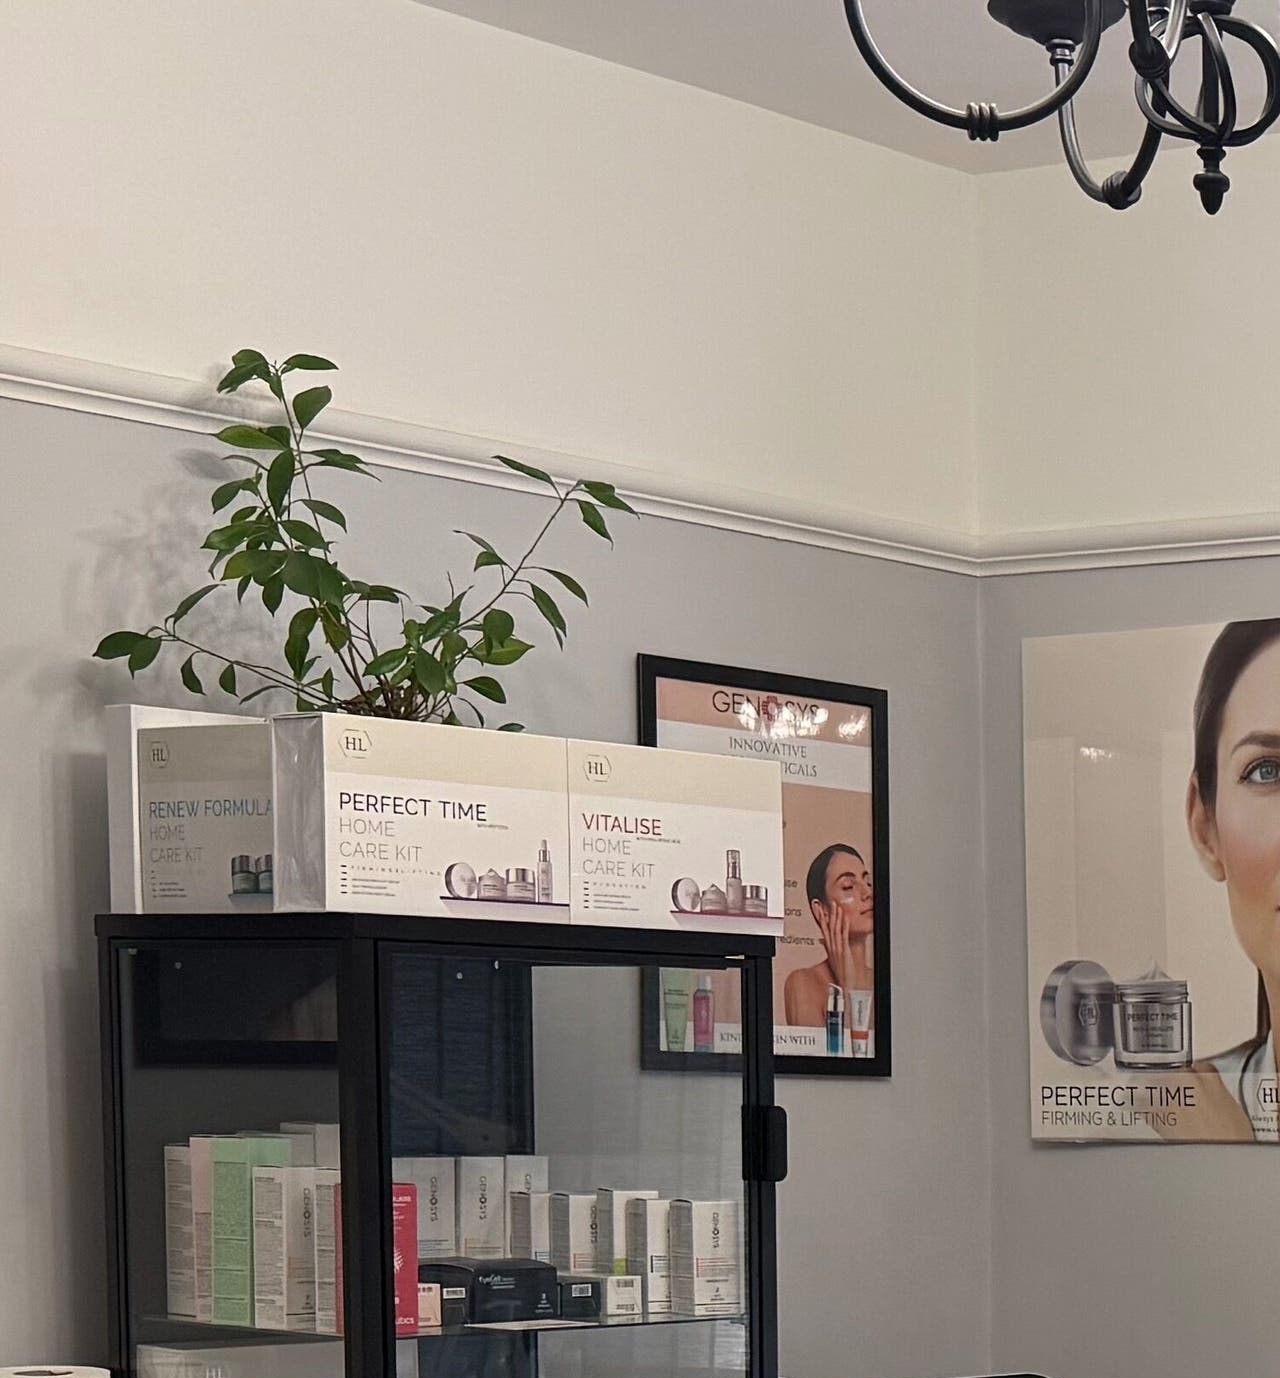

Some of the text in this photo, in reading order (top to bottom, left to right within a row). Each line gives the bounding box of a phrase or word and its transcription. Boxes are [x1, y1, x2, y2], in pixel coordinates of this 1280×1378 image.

[344, 736, 368, 752] HL
[729, 736, 807, 758] INNOVATIVE
[152, 748, 167, 762] HL
[587, 760, 608, 776] HL
[150, 800, 199, 818] RENEW
[339, 791, 488, 822] PERFECT TIME
[151, 824, 186, 841] HOME
[339, 817, 396, 837] HOME
[582, 812, 663, 836] VITALISE
[151, 847, 203, 864] CARE KIT
[339, 841, 423, 863] CARE KIT
[582, 837, 632, 856] HOME
[582, 859, 656, 879] CARE KIT
[1041, 1086, 1197, 1107] PERFECT TIME
[1041, 1111, 1178, 1127] FIRMING & LIFTING
